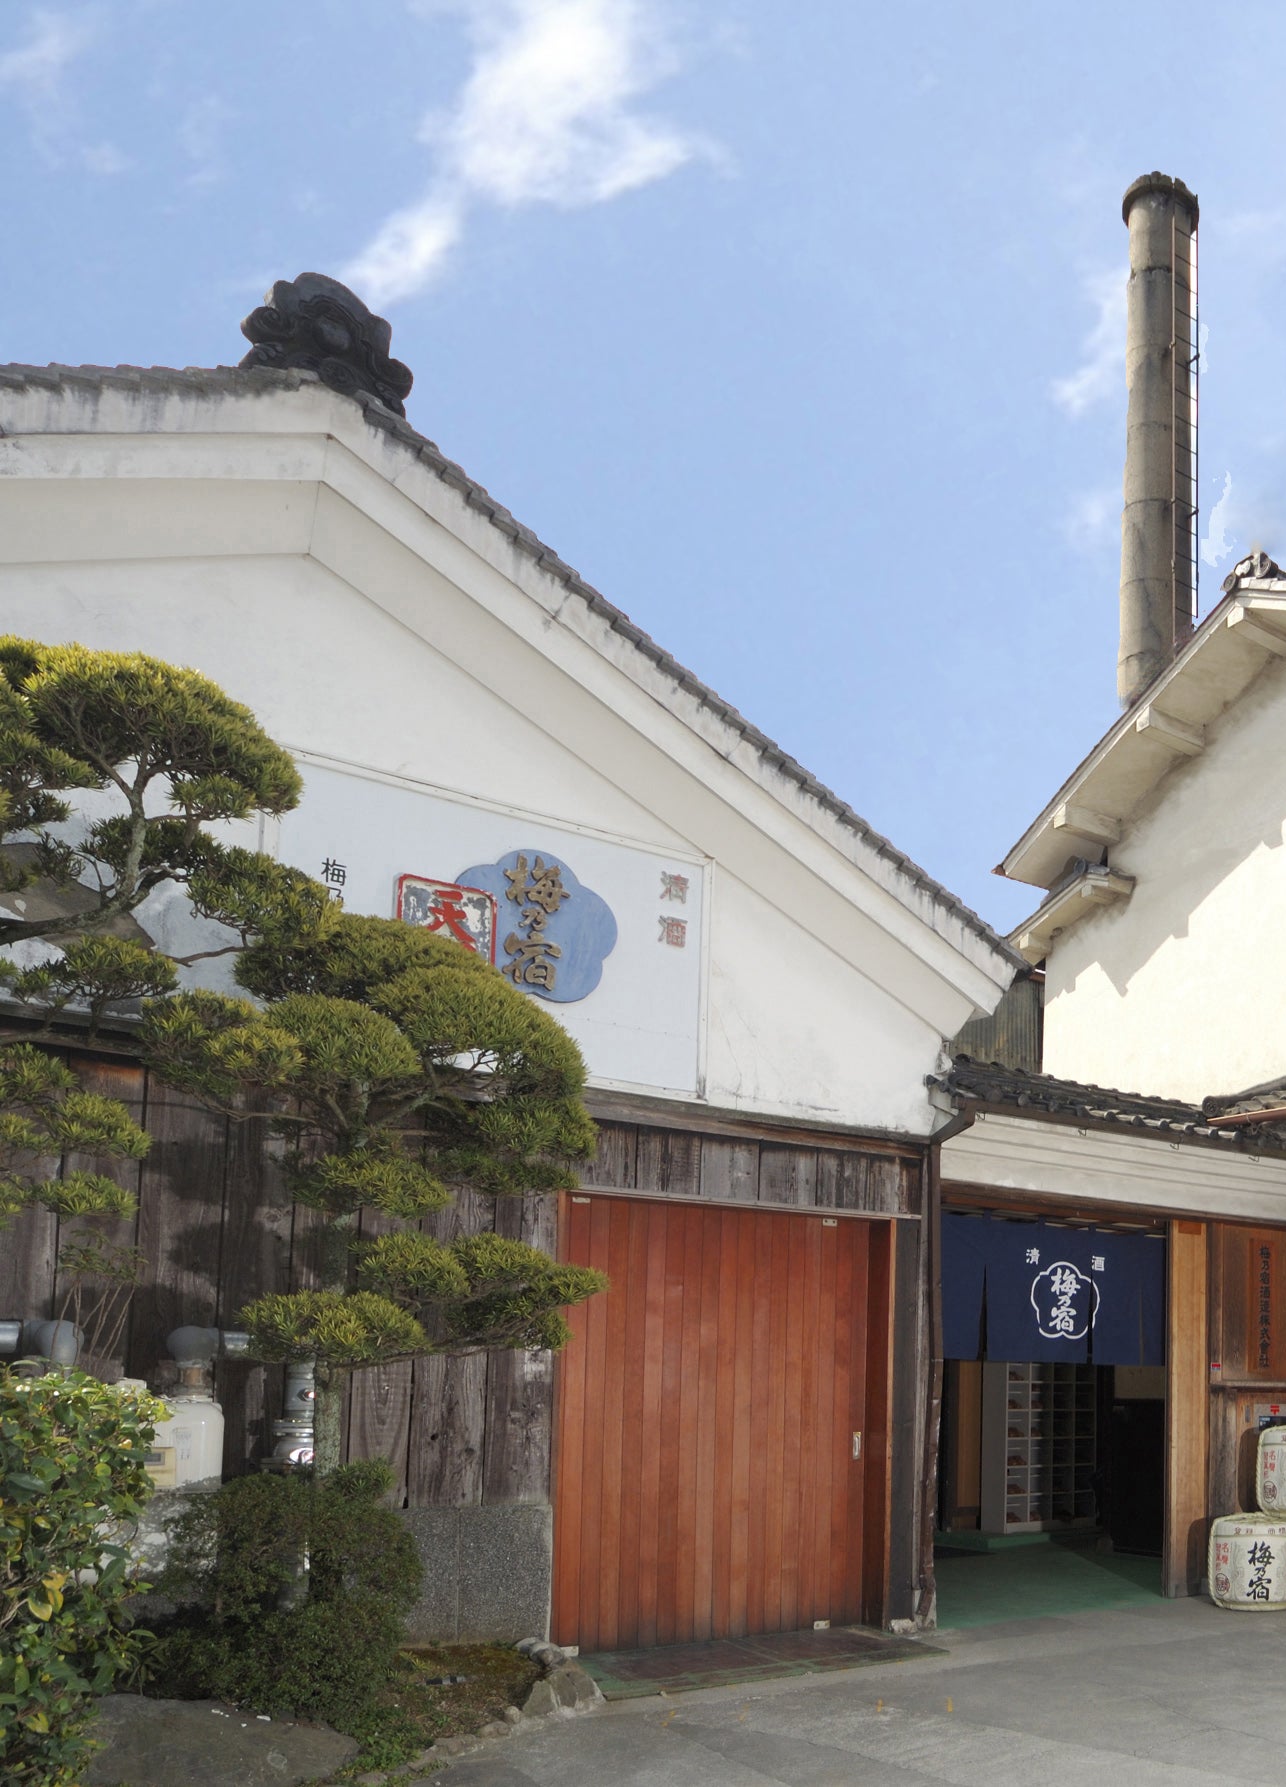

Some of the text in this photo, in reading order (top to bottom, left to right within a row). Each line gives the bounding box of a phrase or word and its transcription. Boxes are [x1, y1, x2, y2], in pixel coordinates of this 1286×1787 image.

[502, 852, 571, 992] 梅乃宿
[658, 870, 690, 948] 清酒
[1049, 1267, 1081, 1332] 梅乃宿
[1246, 1541, 1276, 1601] 梅乃宿
